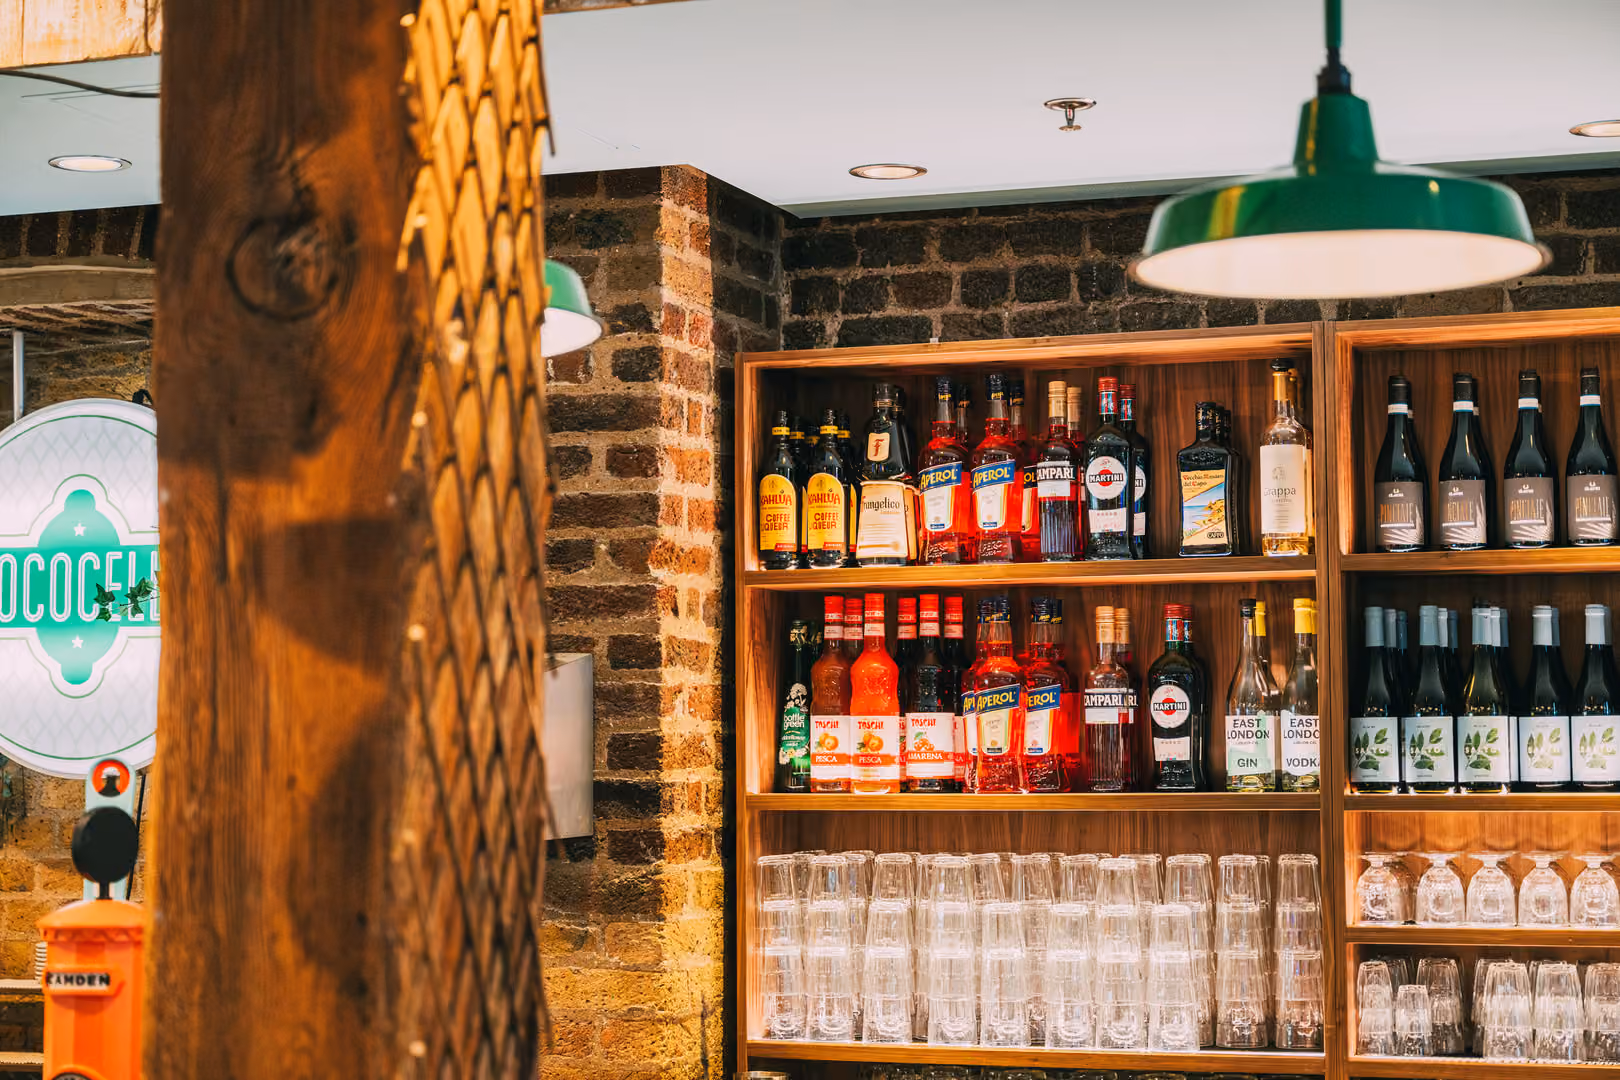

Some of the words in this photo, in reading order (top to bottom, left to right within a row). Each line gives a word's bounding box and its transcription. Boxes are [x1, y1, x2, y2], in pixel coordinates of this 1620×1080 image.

[920, 469, 958, 491] APEROL
[973, 467, 1011, 488] APEROL
[1089, 473, 1123, 483] MARTINI
[814, 512, 839, 521] COFFEE
[977, 691, 1016, 711] APEROL
[1154, 702, 1187, 711] MARTINI
[1233, 719, 1261, 728] EAST
[1290, 719, 1320, 728] EAST
[1228, 730, 1269, 739] LONDON
[1237, 758, 1258, 767] GIN
